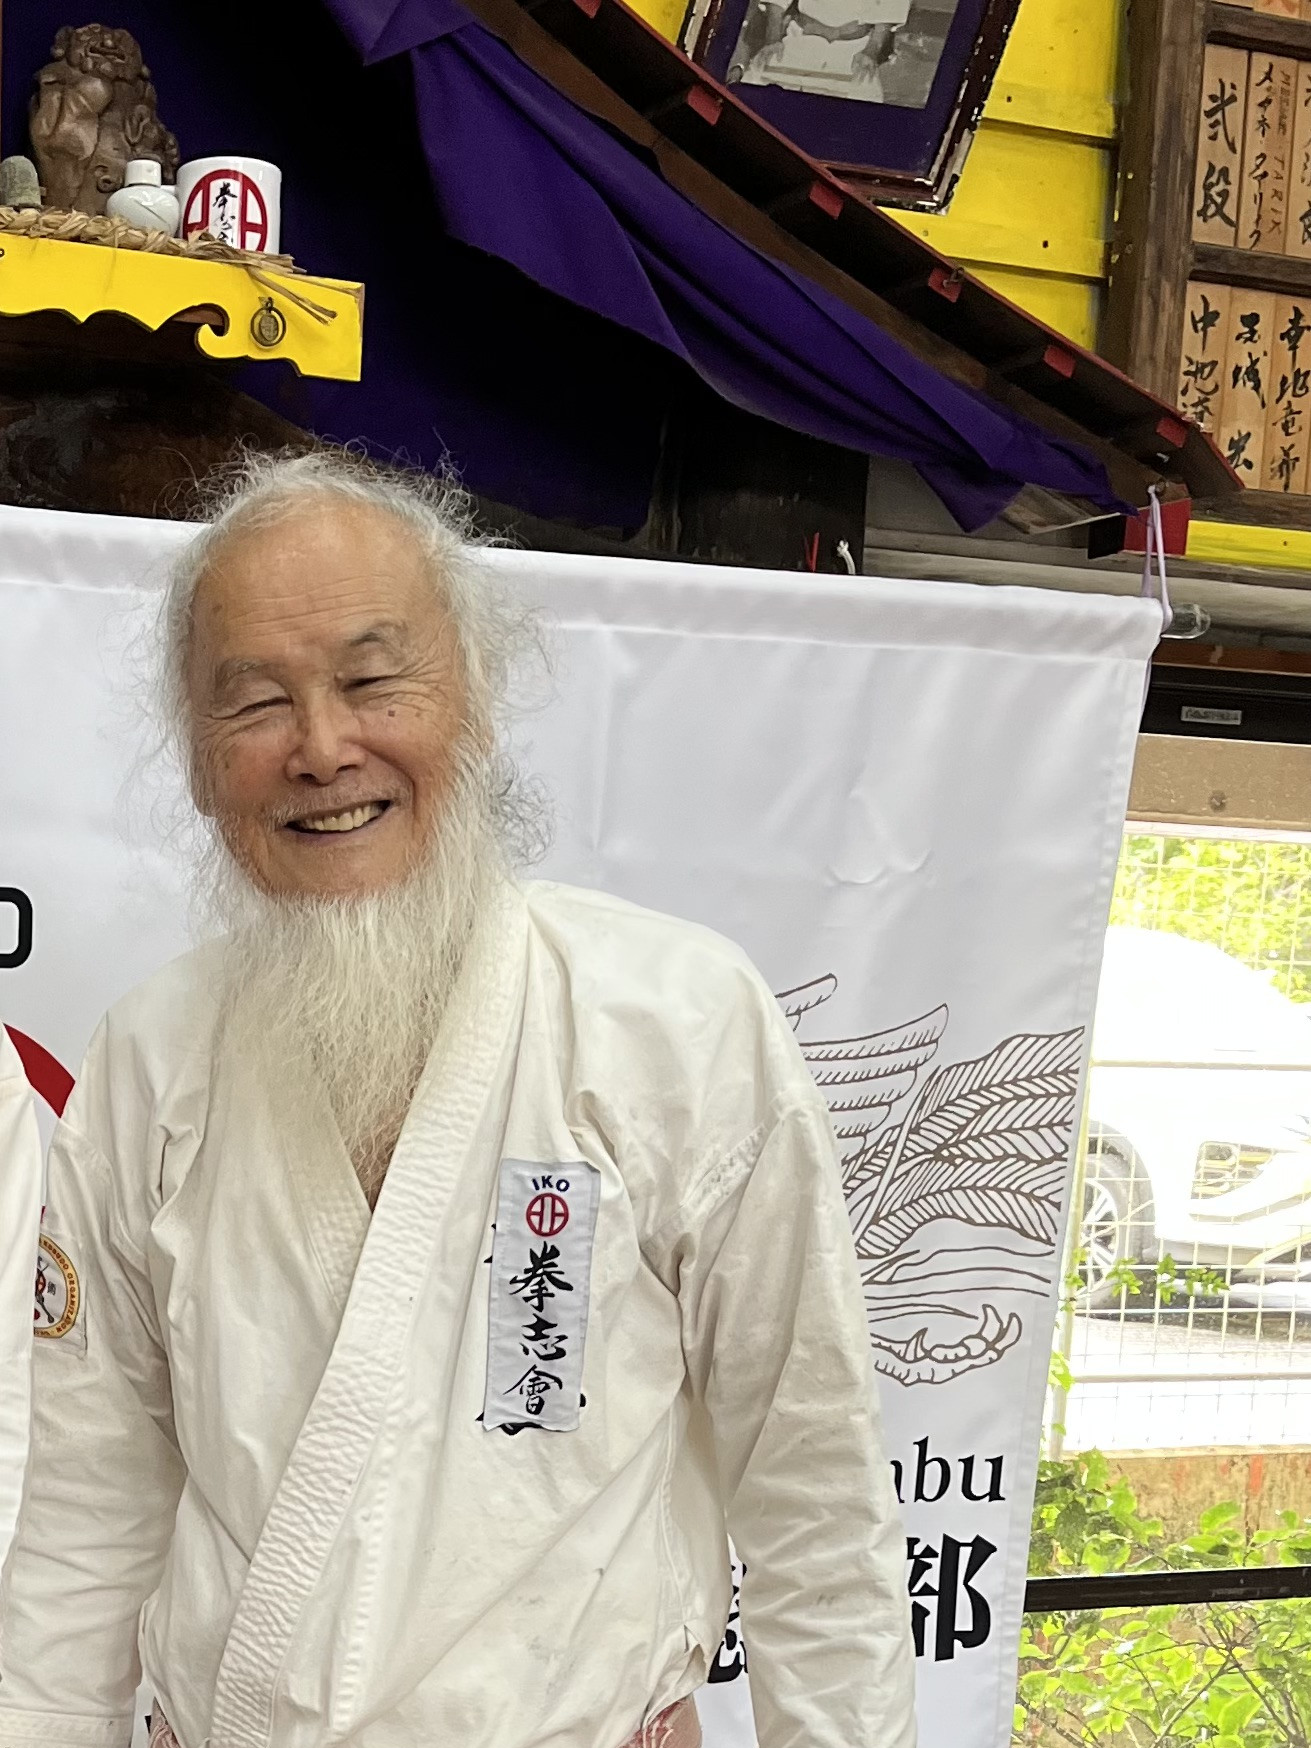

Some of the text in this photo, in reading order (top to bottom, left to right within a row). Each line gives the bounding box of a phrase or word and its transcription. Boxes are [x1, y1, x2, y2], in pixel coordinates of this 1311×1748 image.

[1267, 155, 1287, 236] TARIK
[532, 1175, 570, 1192] IKO
[502, 1241, 574, 1415] 拳志會
